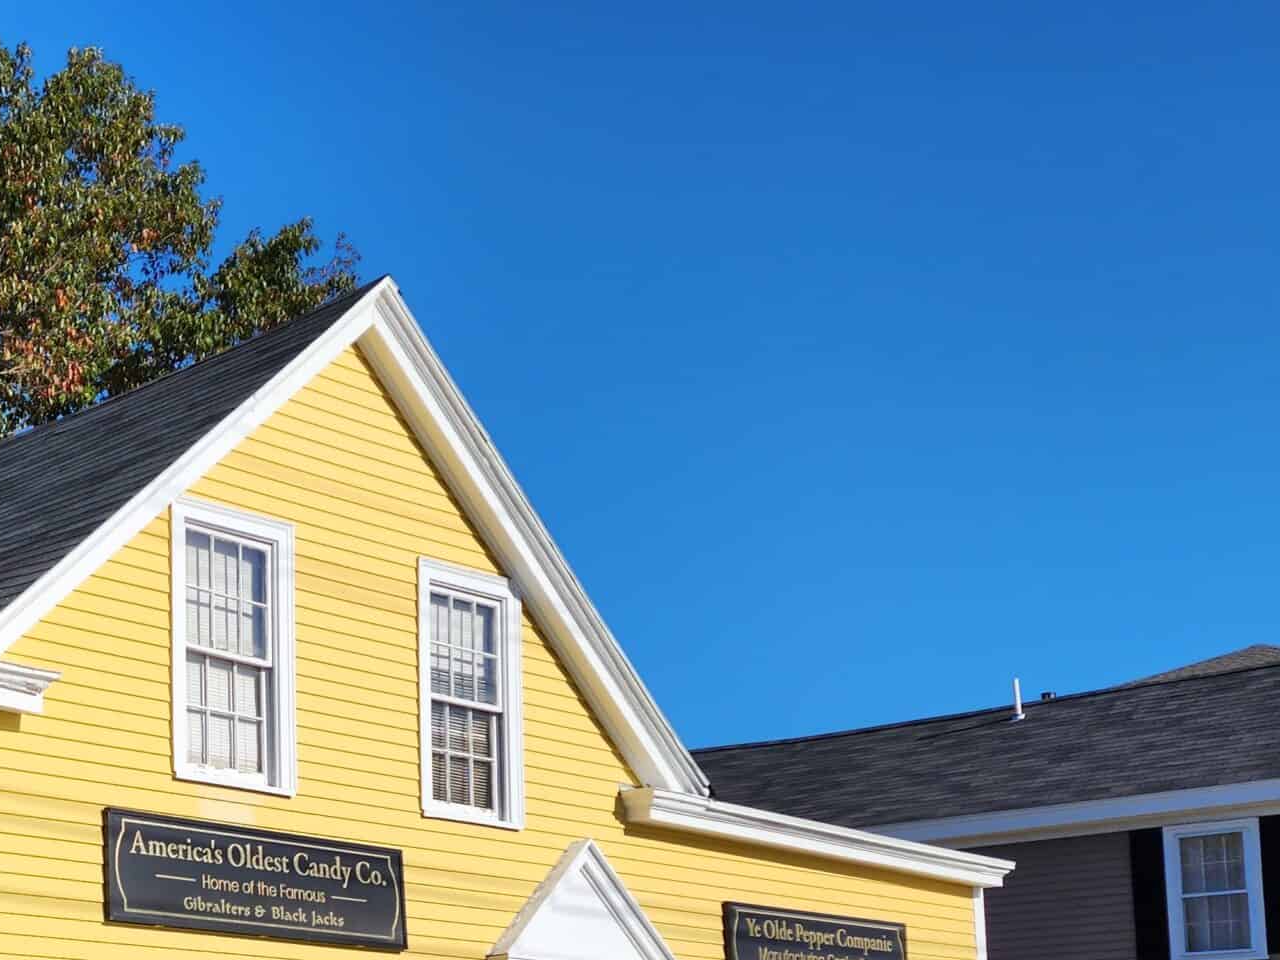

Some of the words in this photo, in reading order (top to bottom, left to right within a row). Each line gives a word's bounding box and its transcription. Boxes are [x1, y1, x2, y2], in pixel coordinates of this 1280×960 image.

[129, 830, 224, 864] America's
[227, 842, 290, 874] Oldest
[293, 852, 351, 889] Candy
[355, 861, 387, 887] Co.
[202, 873, 240, 893] Home
[242, 879, 256, 895] of
[258, 881, 277, 897] the
[280, 884, 326, 904] Famous
[183, 896, 251, 917] Gibralters
[254, 905, 266, 918] &
[272, 908, 307, 922] Black
[311, 911, 345, 927] Jacks
[745, 919, 761, 937] Ye
[763, 919, 793, 940] Olde
[795, 923, 835, 950] Pepper
[836, 928, 893, 955] Companie
